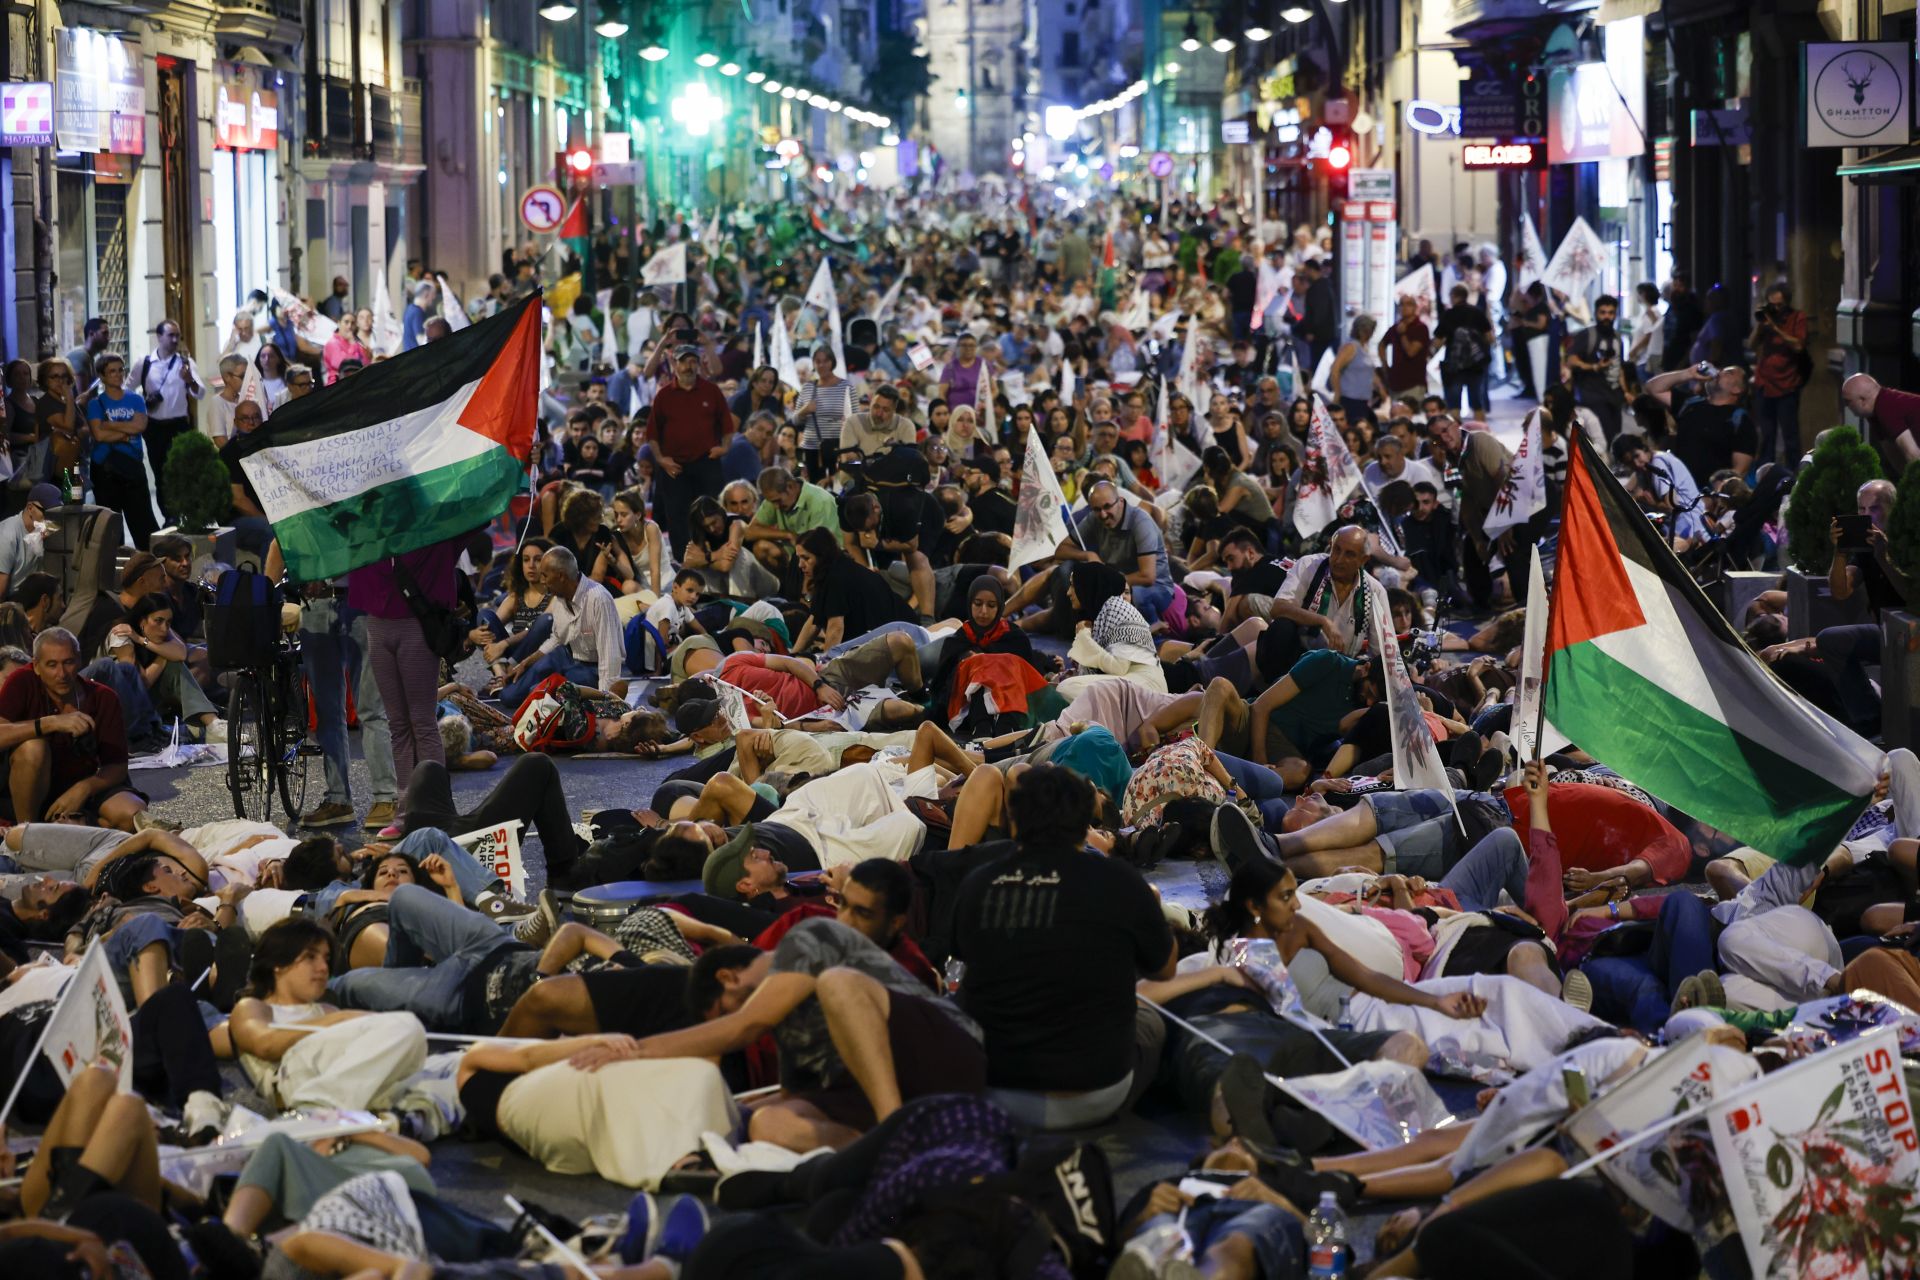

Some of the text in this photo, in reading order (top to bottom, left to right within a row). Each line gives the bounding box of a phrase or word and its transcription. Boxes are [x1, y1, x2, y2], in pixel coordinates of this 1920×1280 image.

[1522, 80, 1542, 136] ORO
[1826, 107, 1890, 117] GHAMTTON
[4, 134, 52, 145] NAUTALIA
[1464, 145, 1533, 165] RELOJES
[319, 448, 398, 488] COMPLICITAT
[1865, 1048, 1918, 1152] STOP
